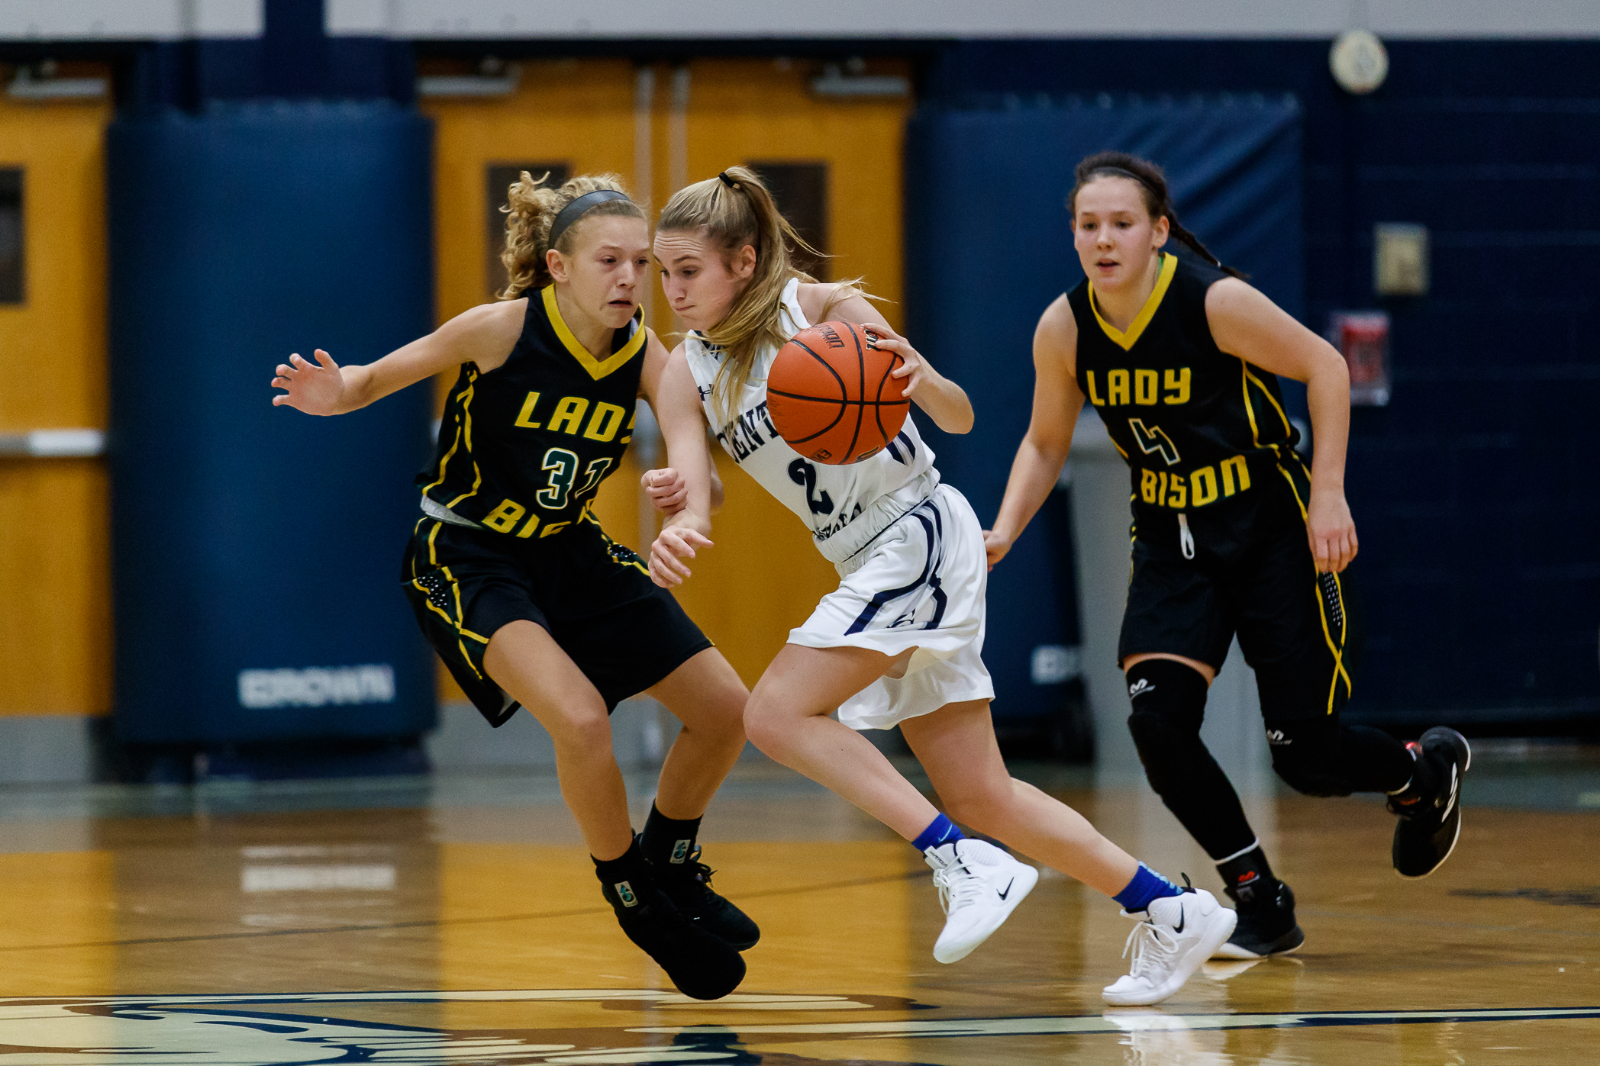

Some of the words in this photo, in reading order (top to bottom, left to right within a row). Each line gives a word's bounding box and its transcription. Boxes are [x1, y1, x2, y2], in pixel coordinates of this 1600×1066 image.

[1086, 367, 1191, 406] LADY
[1128, 418, 1181, 466] 4
[536, 447, 613, 510] 31
[787, 457, 835, 515] 2
[1140, 454, 1251, 509] BISON
